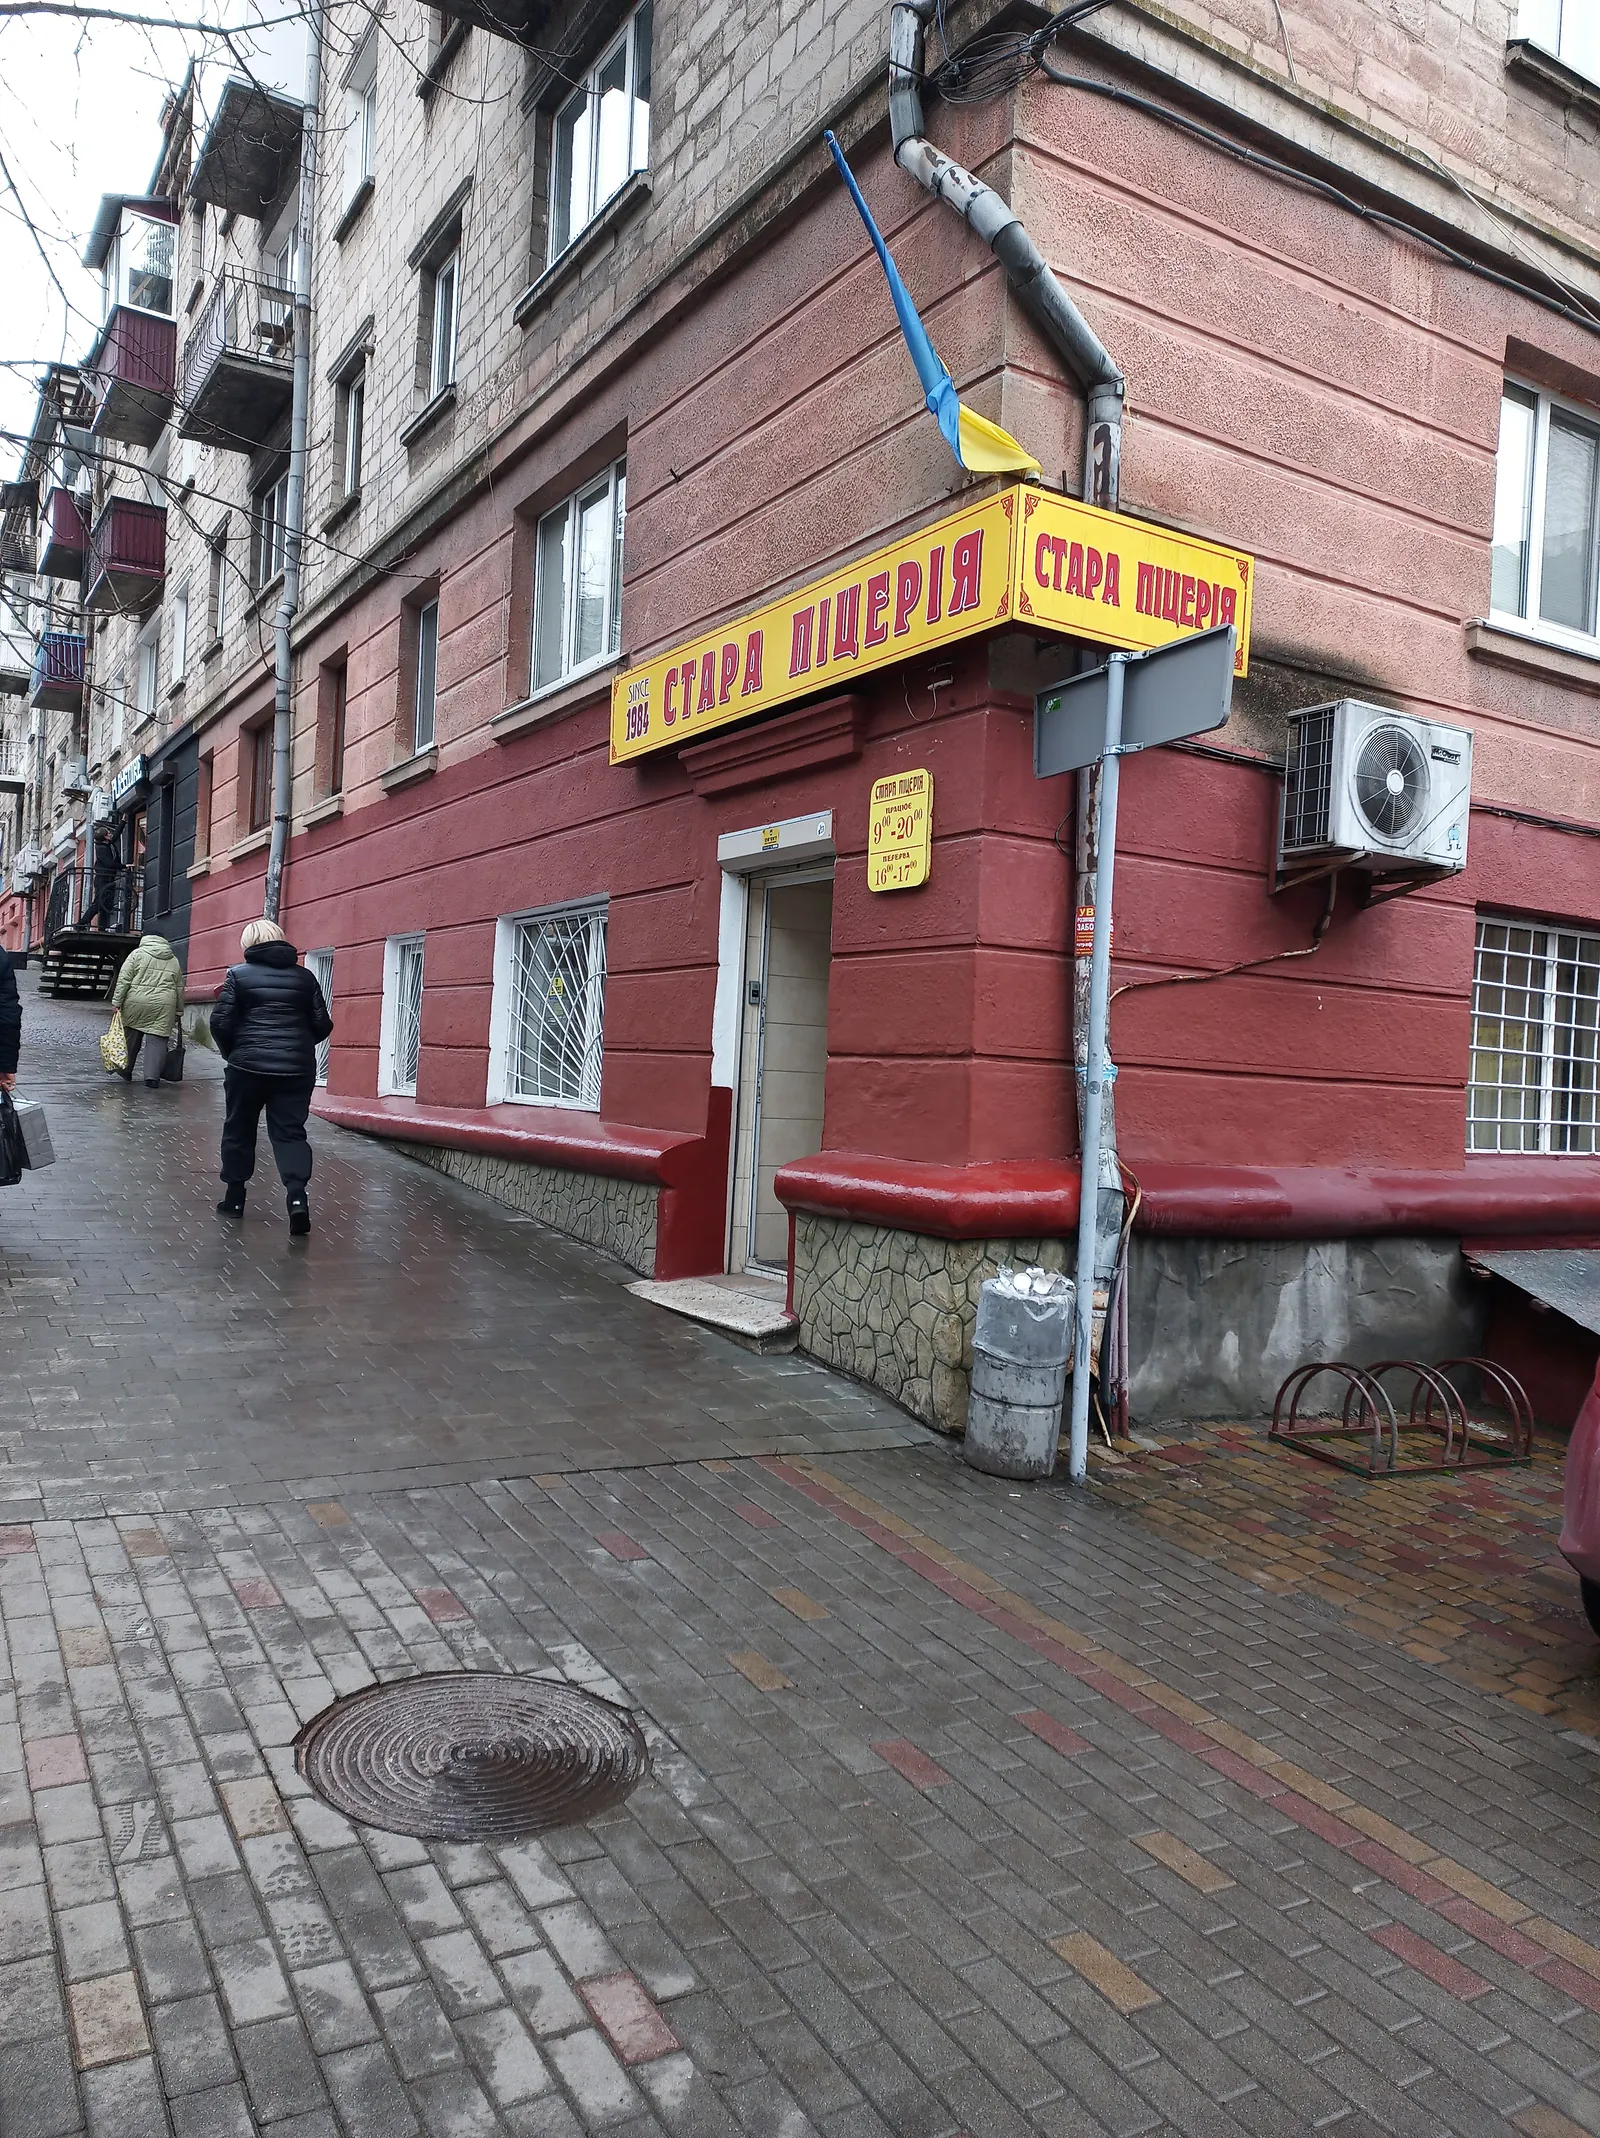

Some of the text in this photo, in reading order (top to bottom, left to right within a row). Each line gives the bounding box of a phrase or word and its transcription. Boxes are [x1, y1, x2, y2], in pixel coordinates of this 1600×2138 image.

[1035, 533, 1237, 629] СТАРА ПІЦЕРІЯ
[664, 528, 984, 726] СТАРА ПІЦЕРІЯ
[627, 678, 650, 704] SINCE
[625, 701, 650, 742] 1984
[885, 803, 912, 814] ПРАЦЮЄ
[882, 852, 911, 863] ПЕРЕРВА
